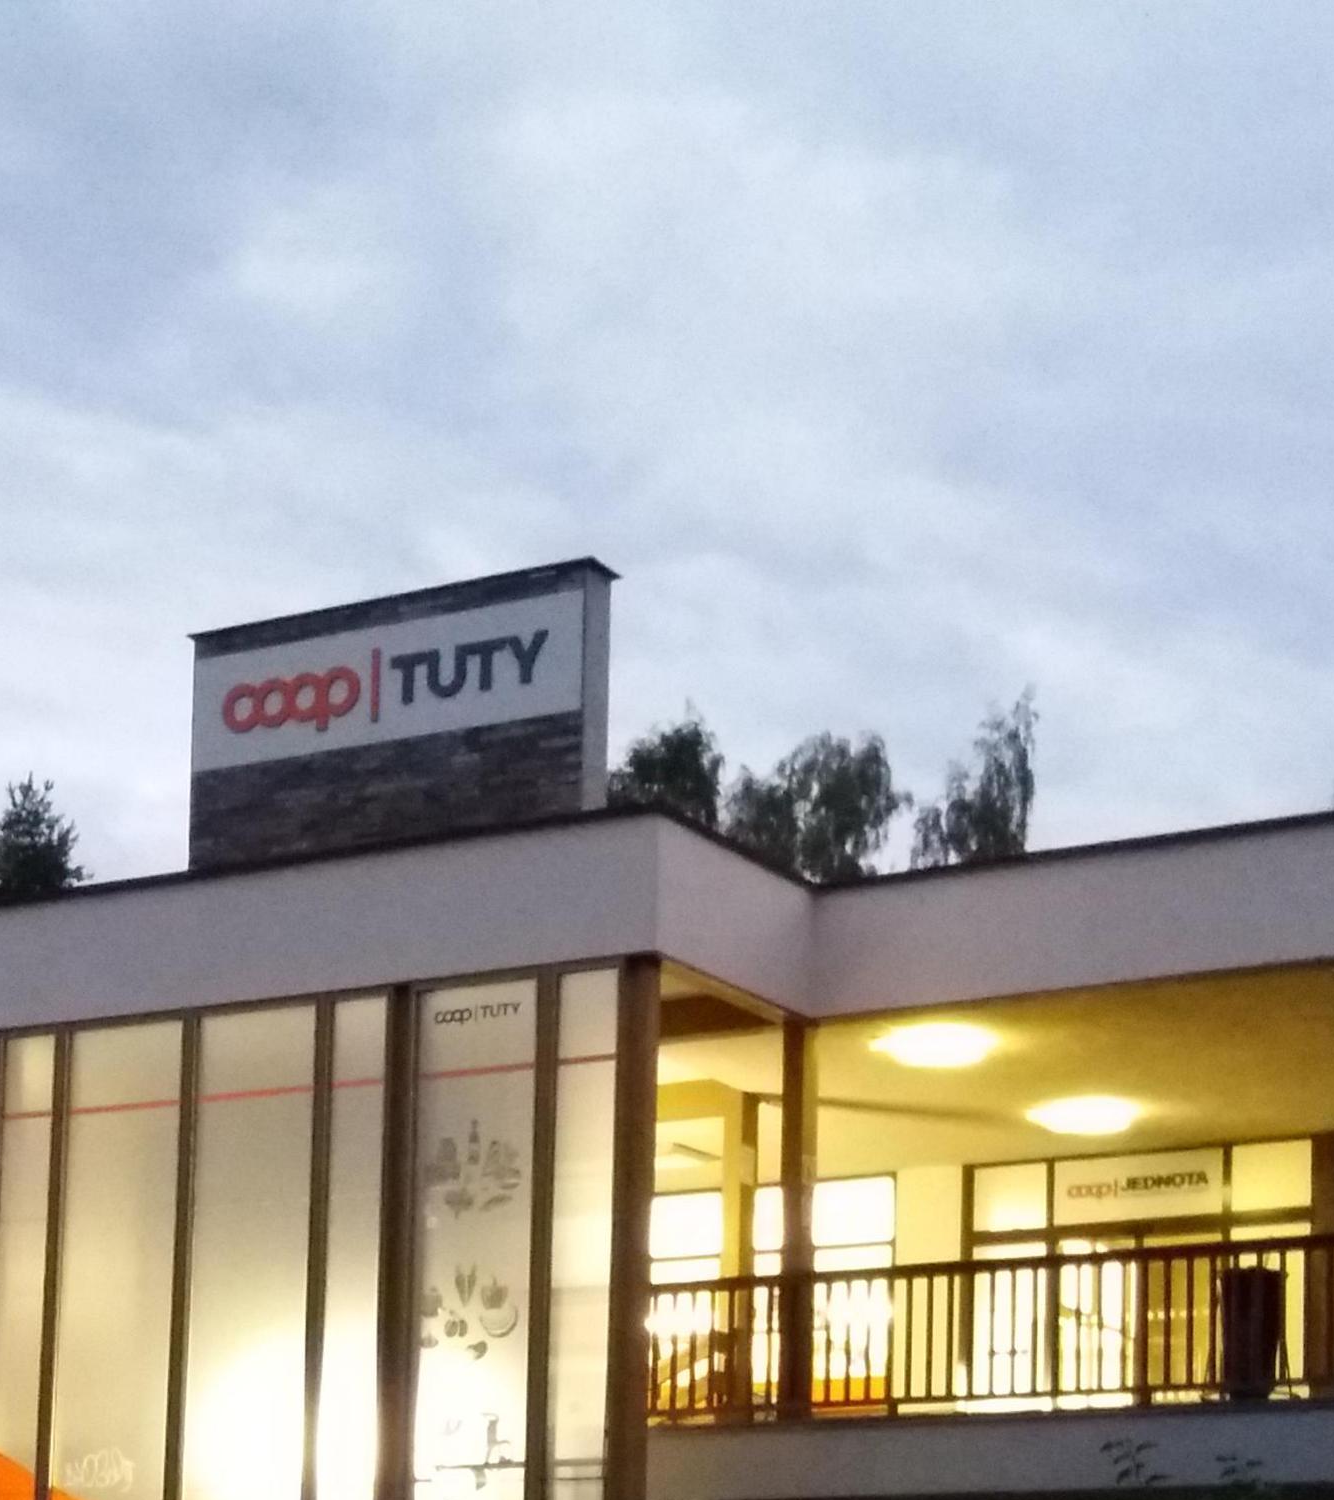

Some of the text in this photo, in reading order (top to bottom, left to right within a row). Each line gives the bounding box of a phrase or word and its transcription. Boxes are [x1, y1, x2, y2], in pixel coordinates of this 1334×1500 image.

[222, 629, 549, 733] coop TUTY
[433, 1001, 522, 1026] coop TUTY
[1120, 1170, 1209, 1192] JEDNOTA
